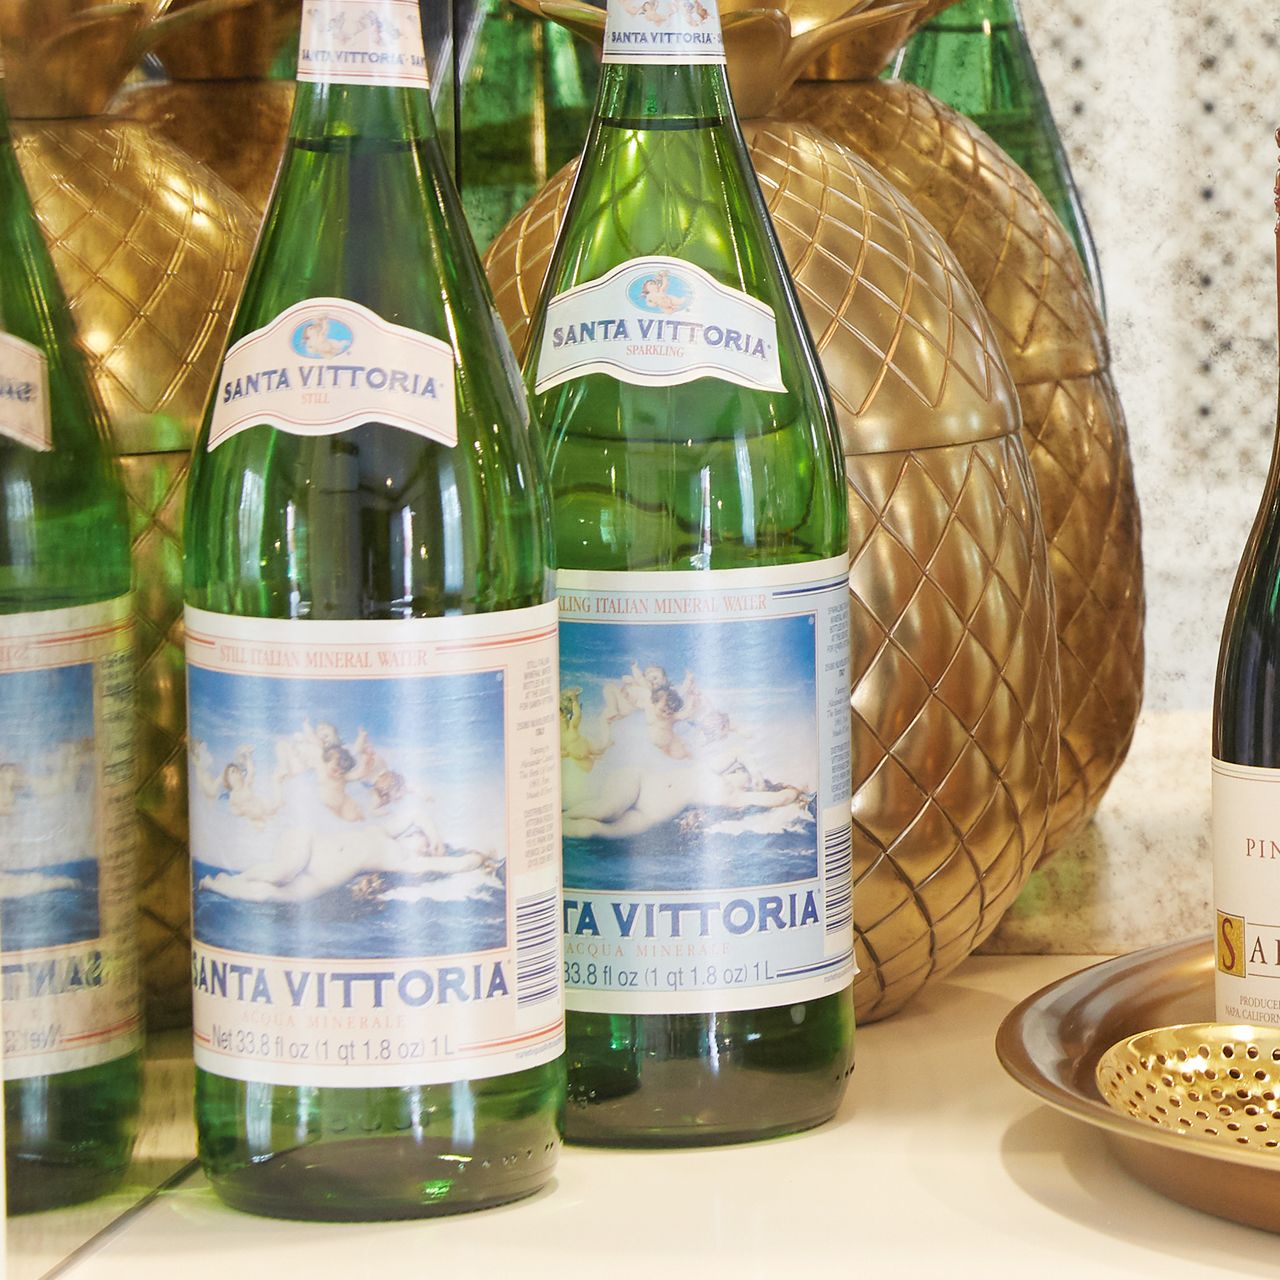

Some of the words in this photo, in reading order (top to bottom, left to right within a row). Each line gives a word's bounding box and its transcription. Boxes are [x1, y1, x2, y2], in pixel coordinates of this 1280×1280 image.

[612, 32, 648, 44] SANTA
[651, 32, 712, 44] VITTORIA
[553, 320, 630, 349] SANTA
[637, 320, 767, 360] VITTORIA
[626, 344, 685, 358] SPARKLING
[223, 368, 291, 404] SANTA
[298, 365, 437, 399] VITTORIA
[302, 393, 330, 404] STILL
[596, 597, 649, 614] ITALIAN
[655, 597, 719, 614] MINERAL
[723, 594, 768, 611] WATER
[219, 645, 248, 664] STILL
[251, 648, 299, 668] ITALIAN
[305, 650, 373, 669] MINERAL
[379, 649, 429, 667] WATER
[612, 890, 821, 937] VITTORIA
[566, 942, 626, 958] ACQUA
[283, 960, 512, 1009] VITTORIA
[618, 969, 639, 987] oz
[667, 965, 684, 991] qt
[693, 965, 717, 986] 1.8
[722, 963, 748, 984] oz)
[241, 1011, 296, 1029] ACQUA
[306, 1015, 407, 1030] MINERALE
[212, 1024, 234, 1051] Net
[237, 1031, 270, 1057] 33.8
[289, 1040, 309, 1060] oz
[337, 1038, 357, 1066] qt
[363, 1038, 392, 1061] 1.8
[398, 1036, 425, 1060] oz)
